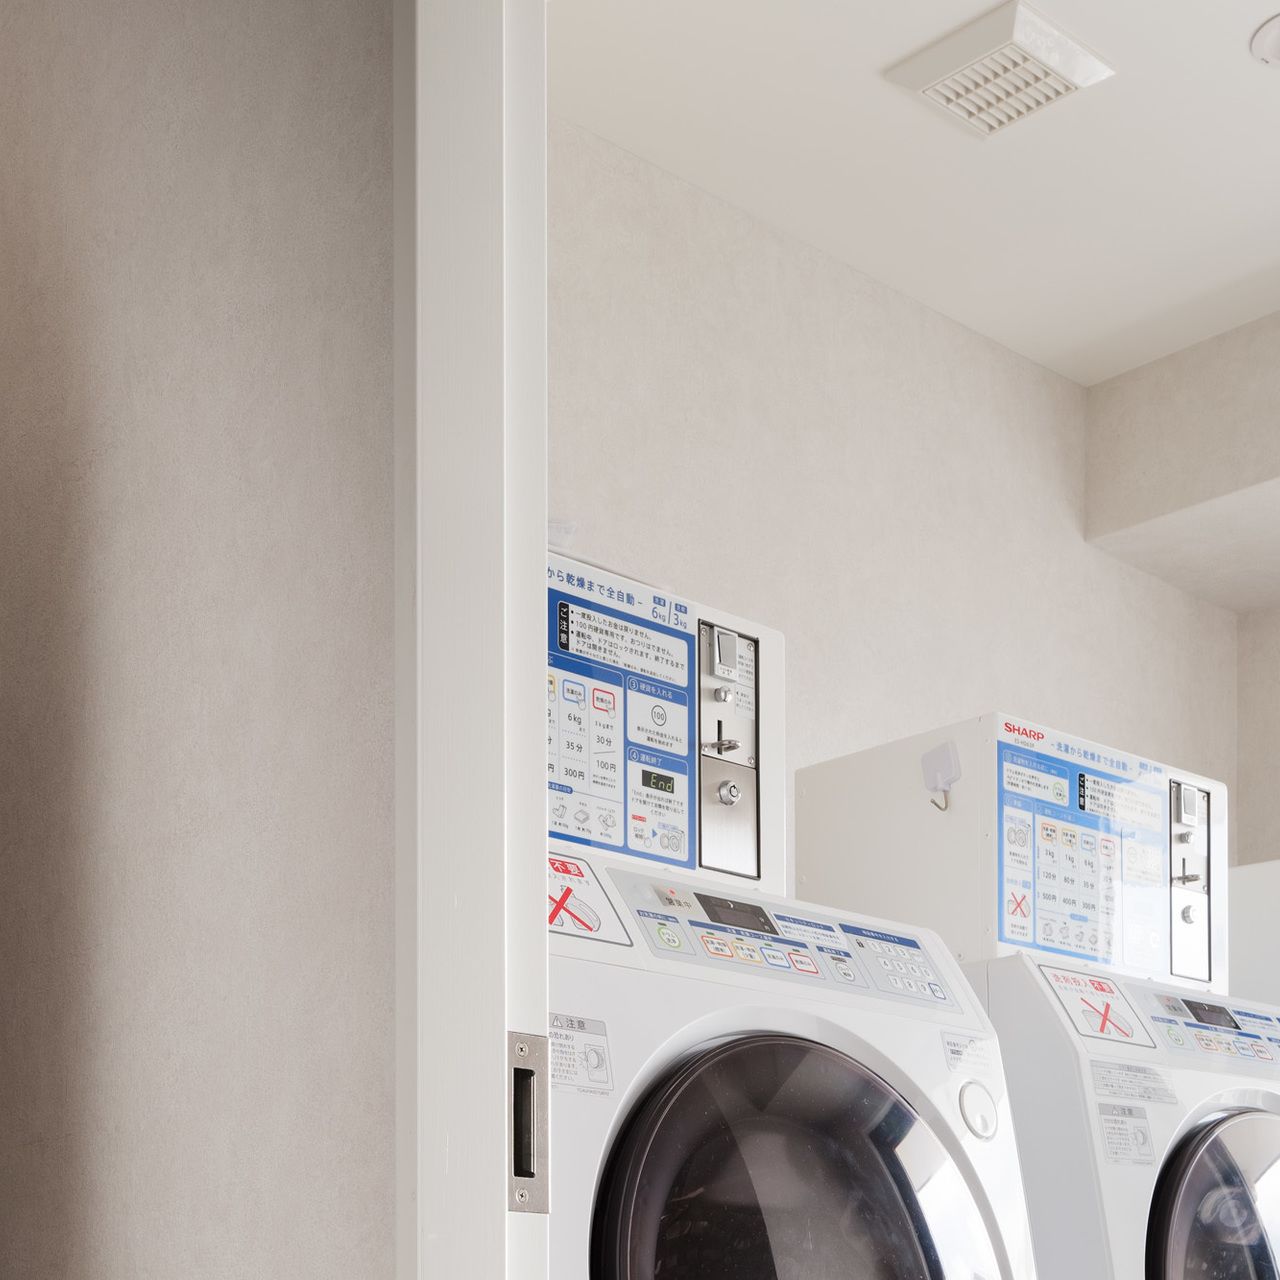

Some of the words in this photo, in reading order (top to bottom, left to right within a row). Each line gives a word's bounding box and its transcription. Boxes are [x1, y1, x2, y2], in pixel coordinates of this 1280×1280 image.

[568, 713, 582, 725] 6kg
[653, 711, 665, 721] 100
[1004, 721, 1045, 741] SHARP
[566, 740, 583, 753] 35分
[596, 735, 612, 747] 30分
[596, 760, 616, 773] 100円
[564, 767, 585, 781] 300円
[651, 773, 673, 791] End
